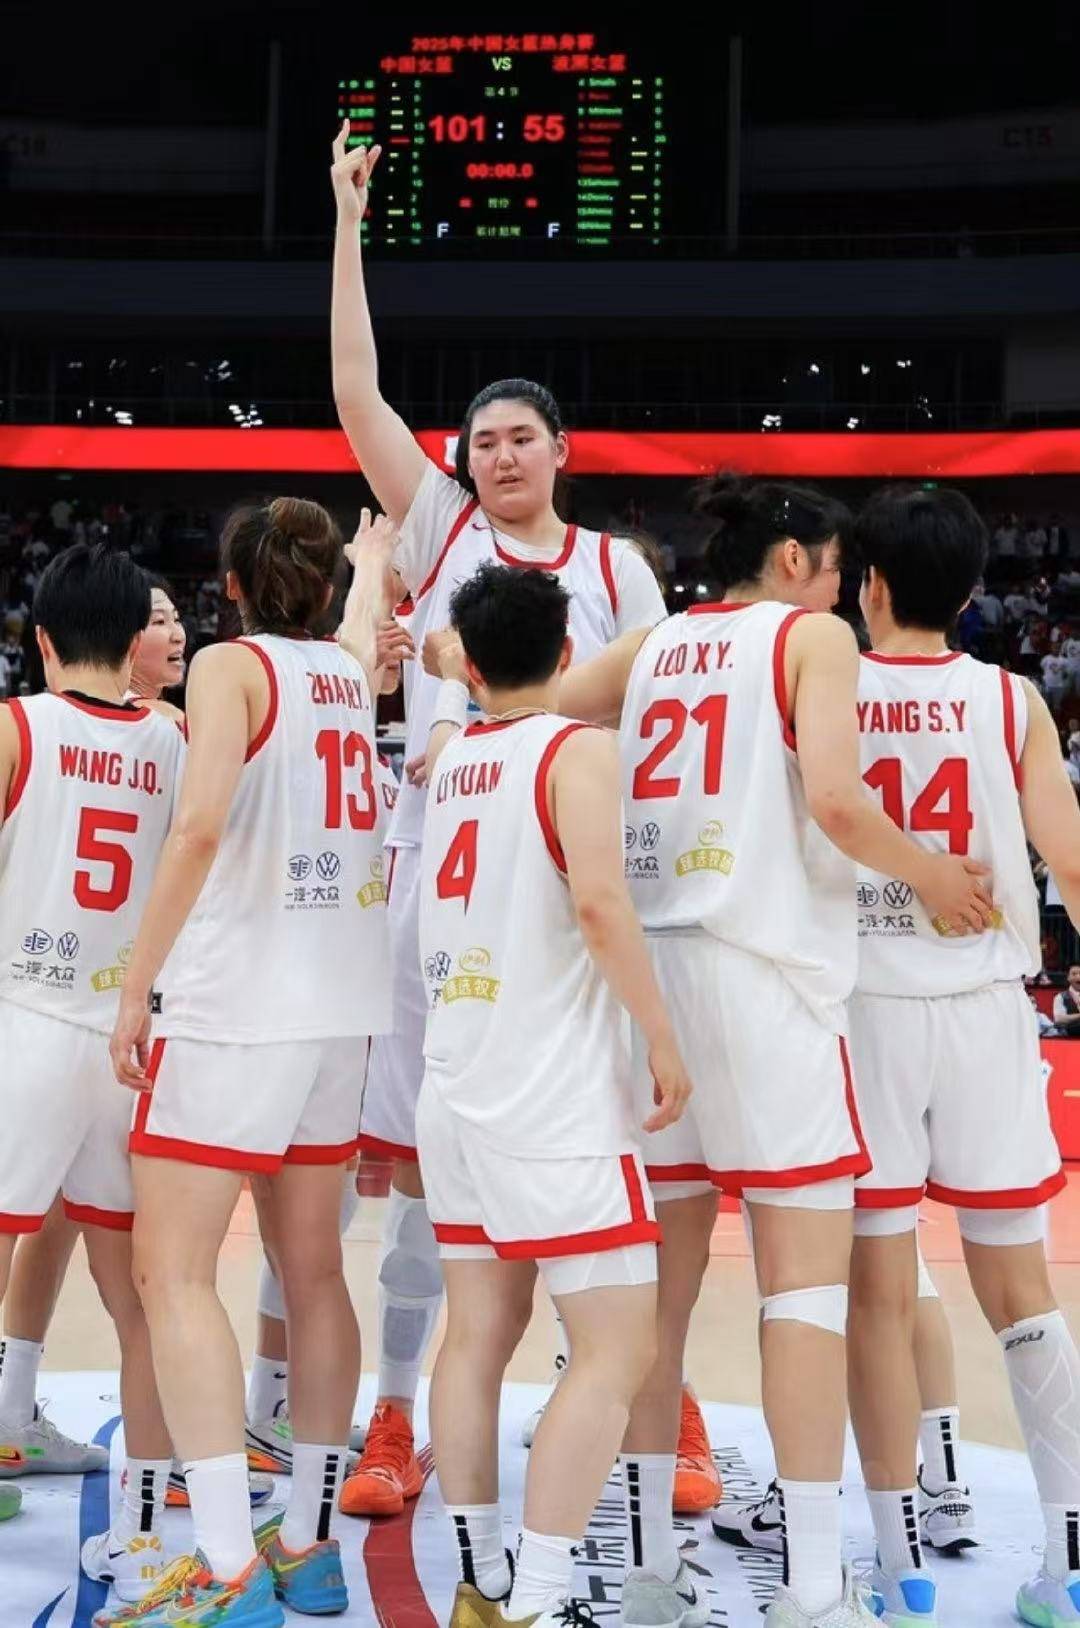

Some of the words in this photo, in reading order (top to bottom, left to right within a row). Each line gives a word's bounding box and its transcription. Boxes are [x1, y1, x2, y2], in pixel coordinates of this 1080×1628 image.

[492, 56, 512, 71] VS
[428, 114, 485, 142] 101
[523, 114, 565, 142] 55
[466, 162, 534, 178] 00:00.0
[436, 222, 450, 238] F
[547, 222, 561, 238] F
[856, 700, 920, 732] YANG
[632, 694, 729, 801] 21
[59, 744, 122, 786] WANG
[128, 758, 162, 795] J.Q.
[315, 729, 377, 830] 13
[862, 757, 973, 856] 14
[73, 806, 139, 913] 5
[436, 818, 479, 916] 4
